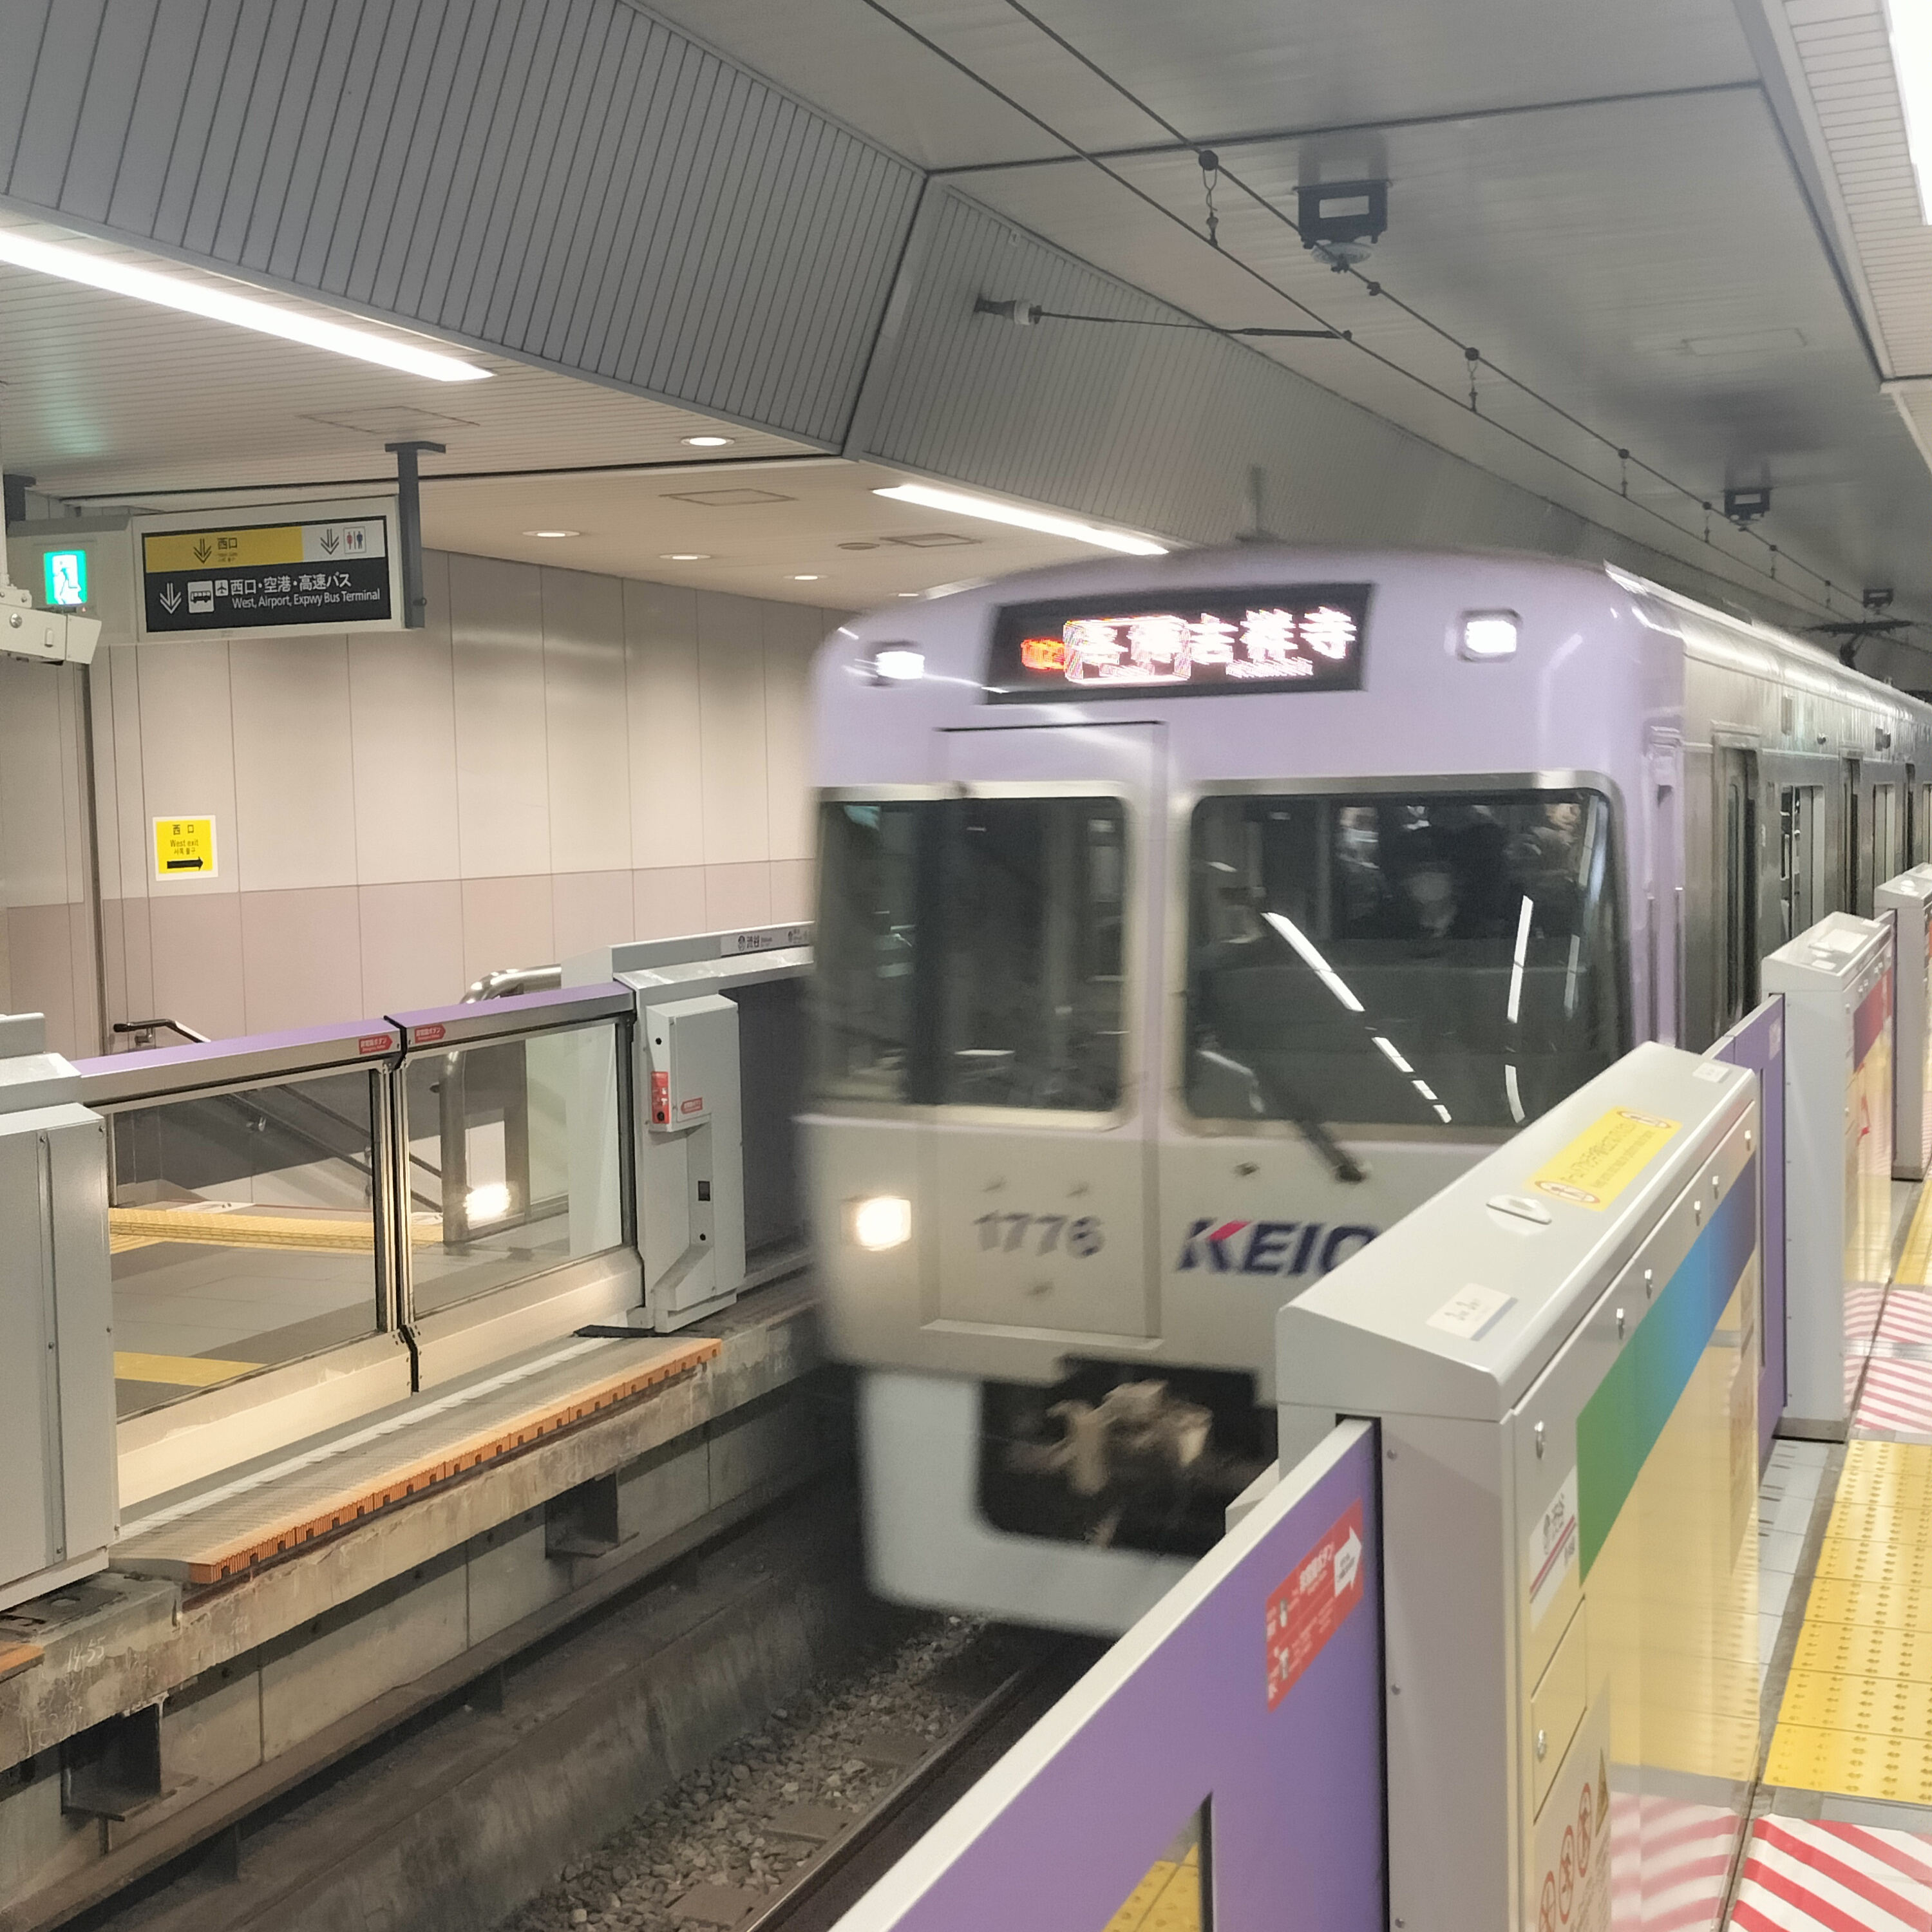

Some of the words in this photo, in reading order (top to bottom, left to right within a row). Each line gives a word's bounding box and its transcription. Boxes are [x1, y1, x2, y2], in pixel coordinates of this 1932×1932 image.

[217, 537, 238, 549] 西口
[232, 596, 257, 609] West,
[258, 595, 292, 609] Airport,
[294, 593, 323, 607] Expwy
[324, 592, 340, 603] Bus
[341, 587, 380, 602] Terminal
